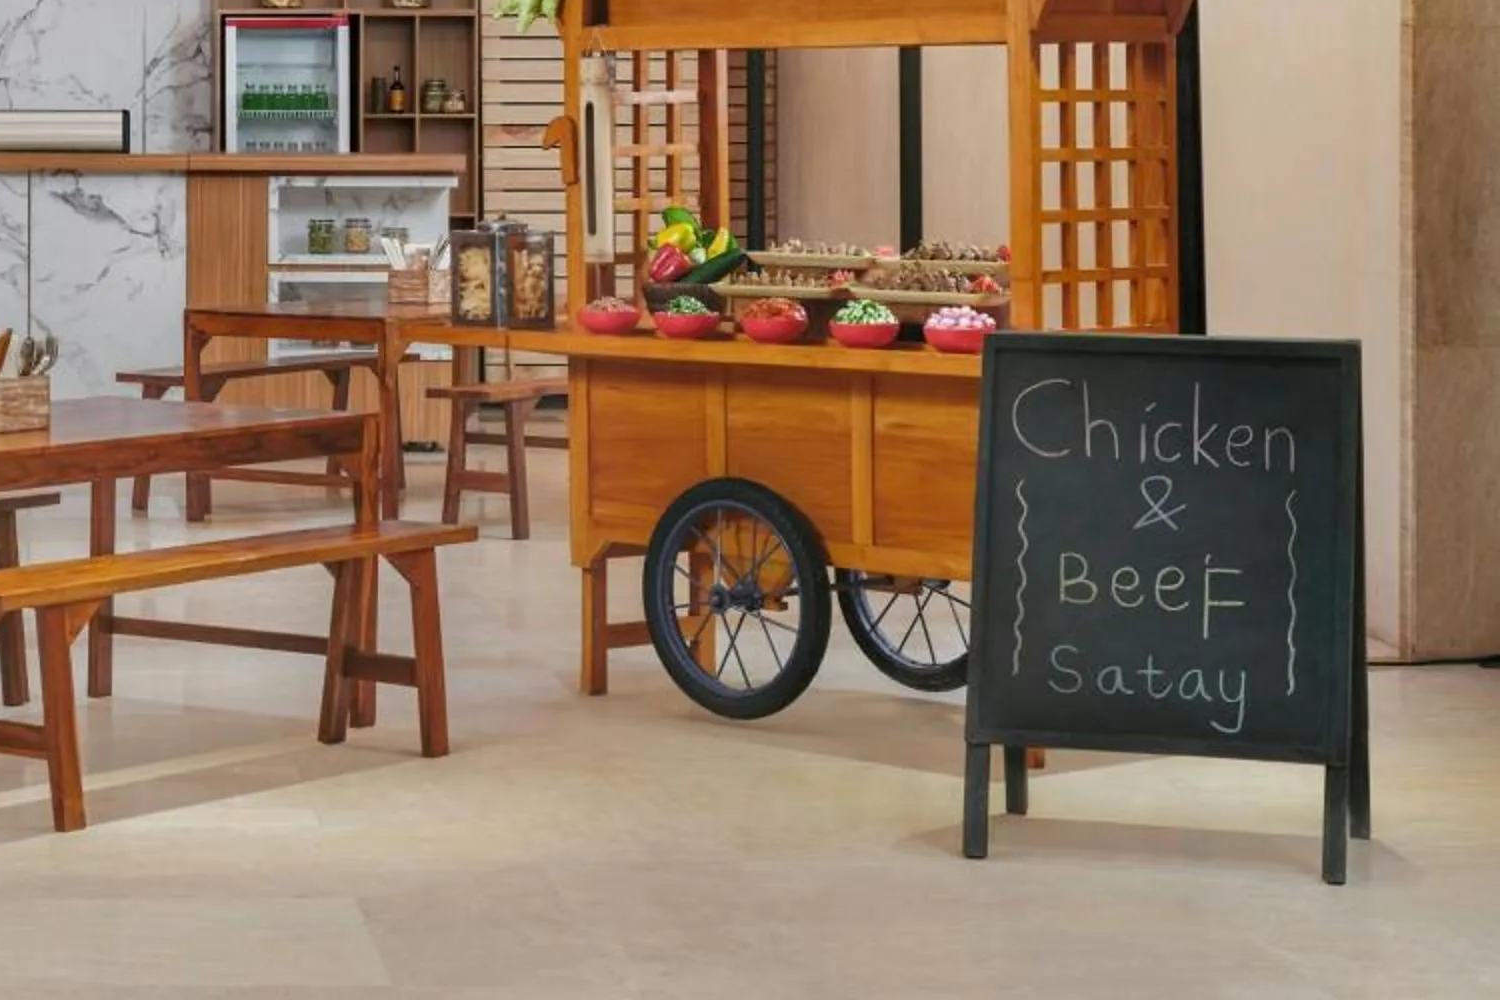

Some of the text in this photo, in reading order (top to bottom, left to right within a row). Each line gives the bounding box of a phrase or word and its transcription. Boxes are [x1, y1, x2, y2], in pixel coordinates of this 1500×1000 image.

[1011, 377, 1296, 473] Chicken
[1132, 474, 1187, 531] &
[1047, 644, 1247, 733] Satay
